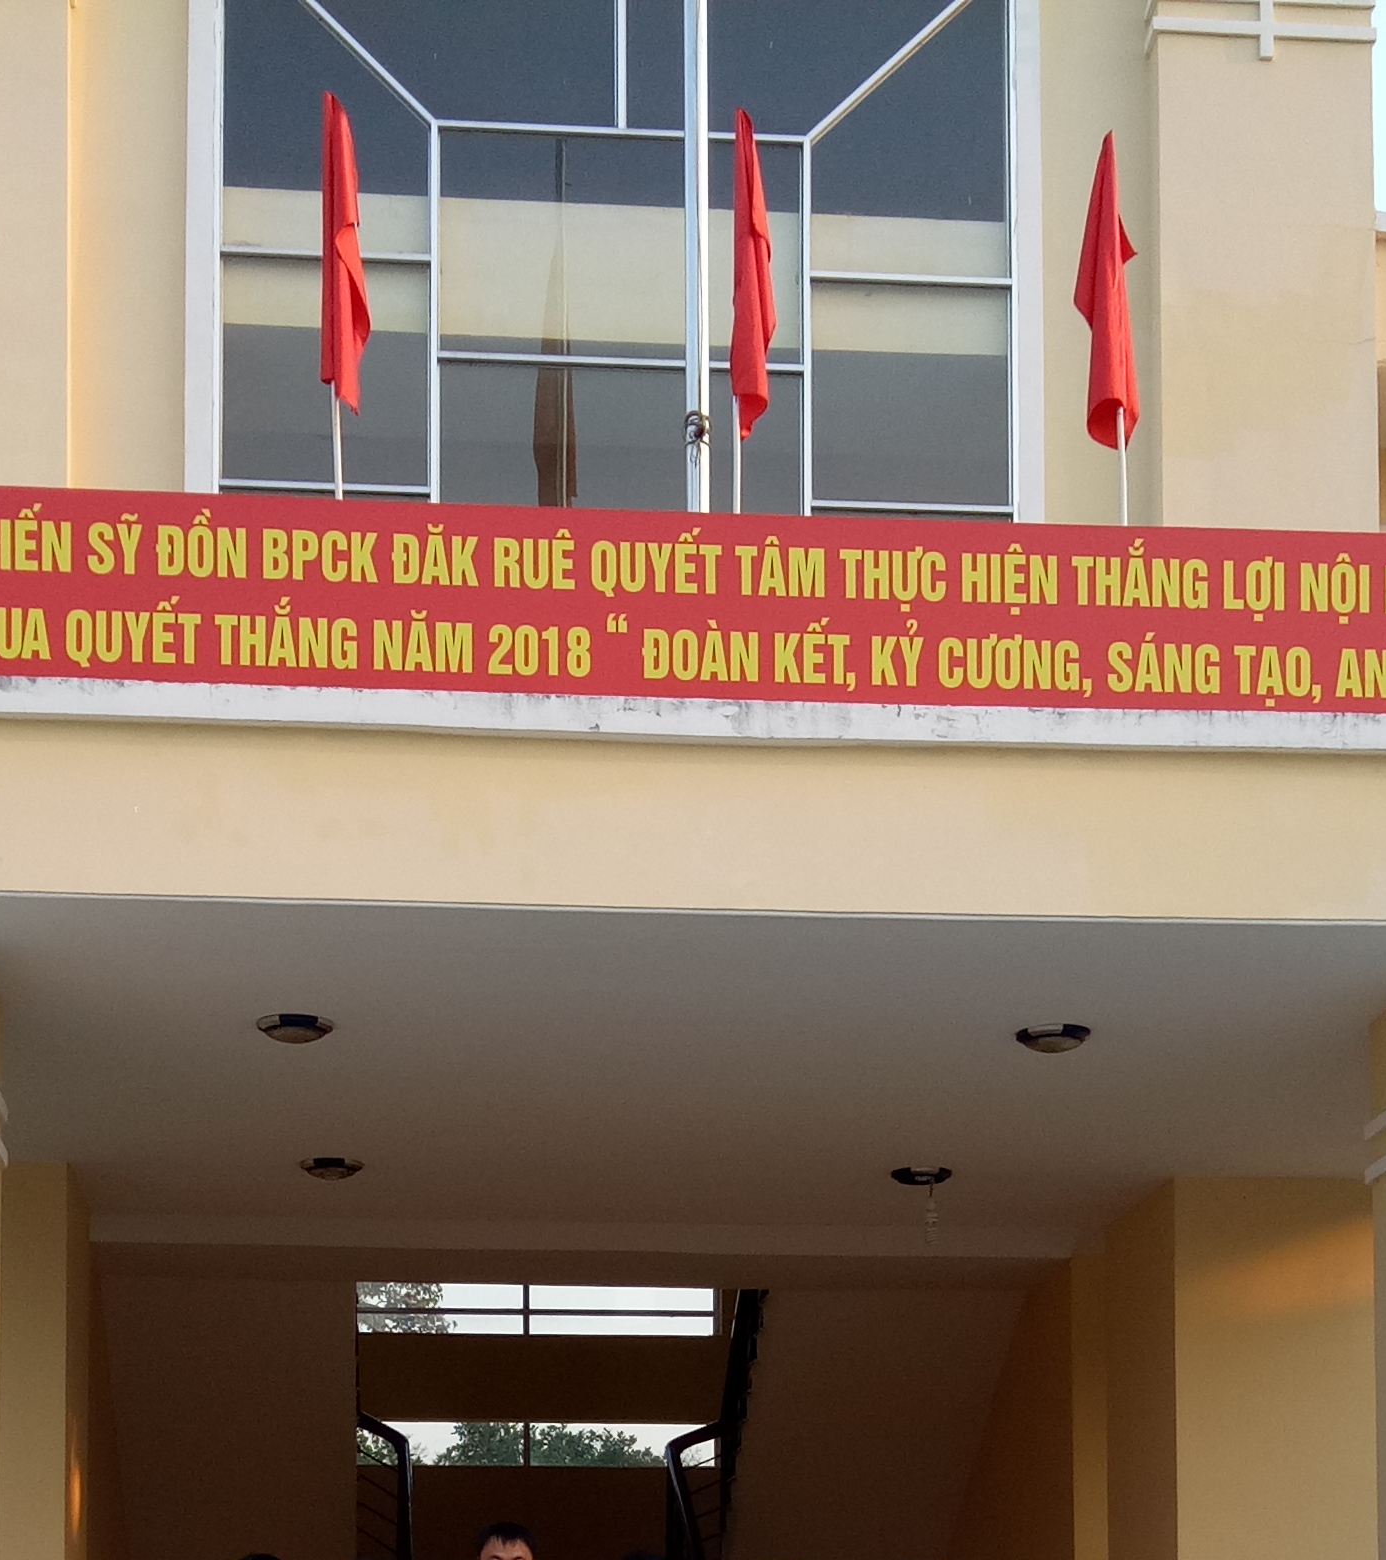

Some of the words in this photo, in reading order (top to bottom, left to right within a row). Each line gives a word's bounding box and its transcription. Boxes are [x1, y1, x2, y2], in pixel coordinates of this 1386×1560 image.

[87, 514, 143, 575] SỸ
[156, 509, 247, 579] ĐỒN
[262, 528, 378, 583] BPCK
[391, 525, 479, 587] ĐĂK
[494, 529, 576, 590] RUÊ
[591, 528, 723, 598] QUYẾT
[735, 536, 826, 598] TÂM
[839, 546, 947, 613] THỰC
[961, 543, 1058, 616] HIỆN
[1071, 537, 1209, 610] THẮNG
[1223, 556, 1285, 622] LỢI
[1300, 553, 1370, 625] NỘI
[65, 596, 202, 668] QUYẾT
[214, 597, 358, 670] THẮNG
[373, 610, 473, 674] NĂM
[488, 624, 591, 678] 2018
[872, 619, 924, 687] KỶ
[1107, 632, 1221, 695] SÁNG
